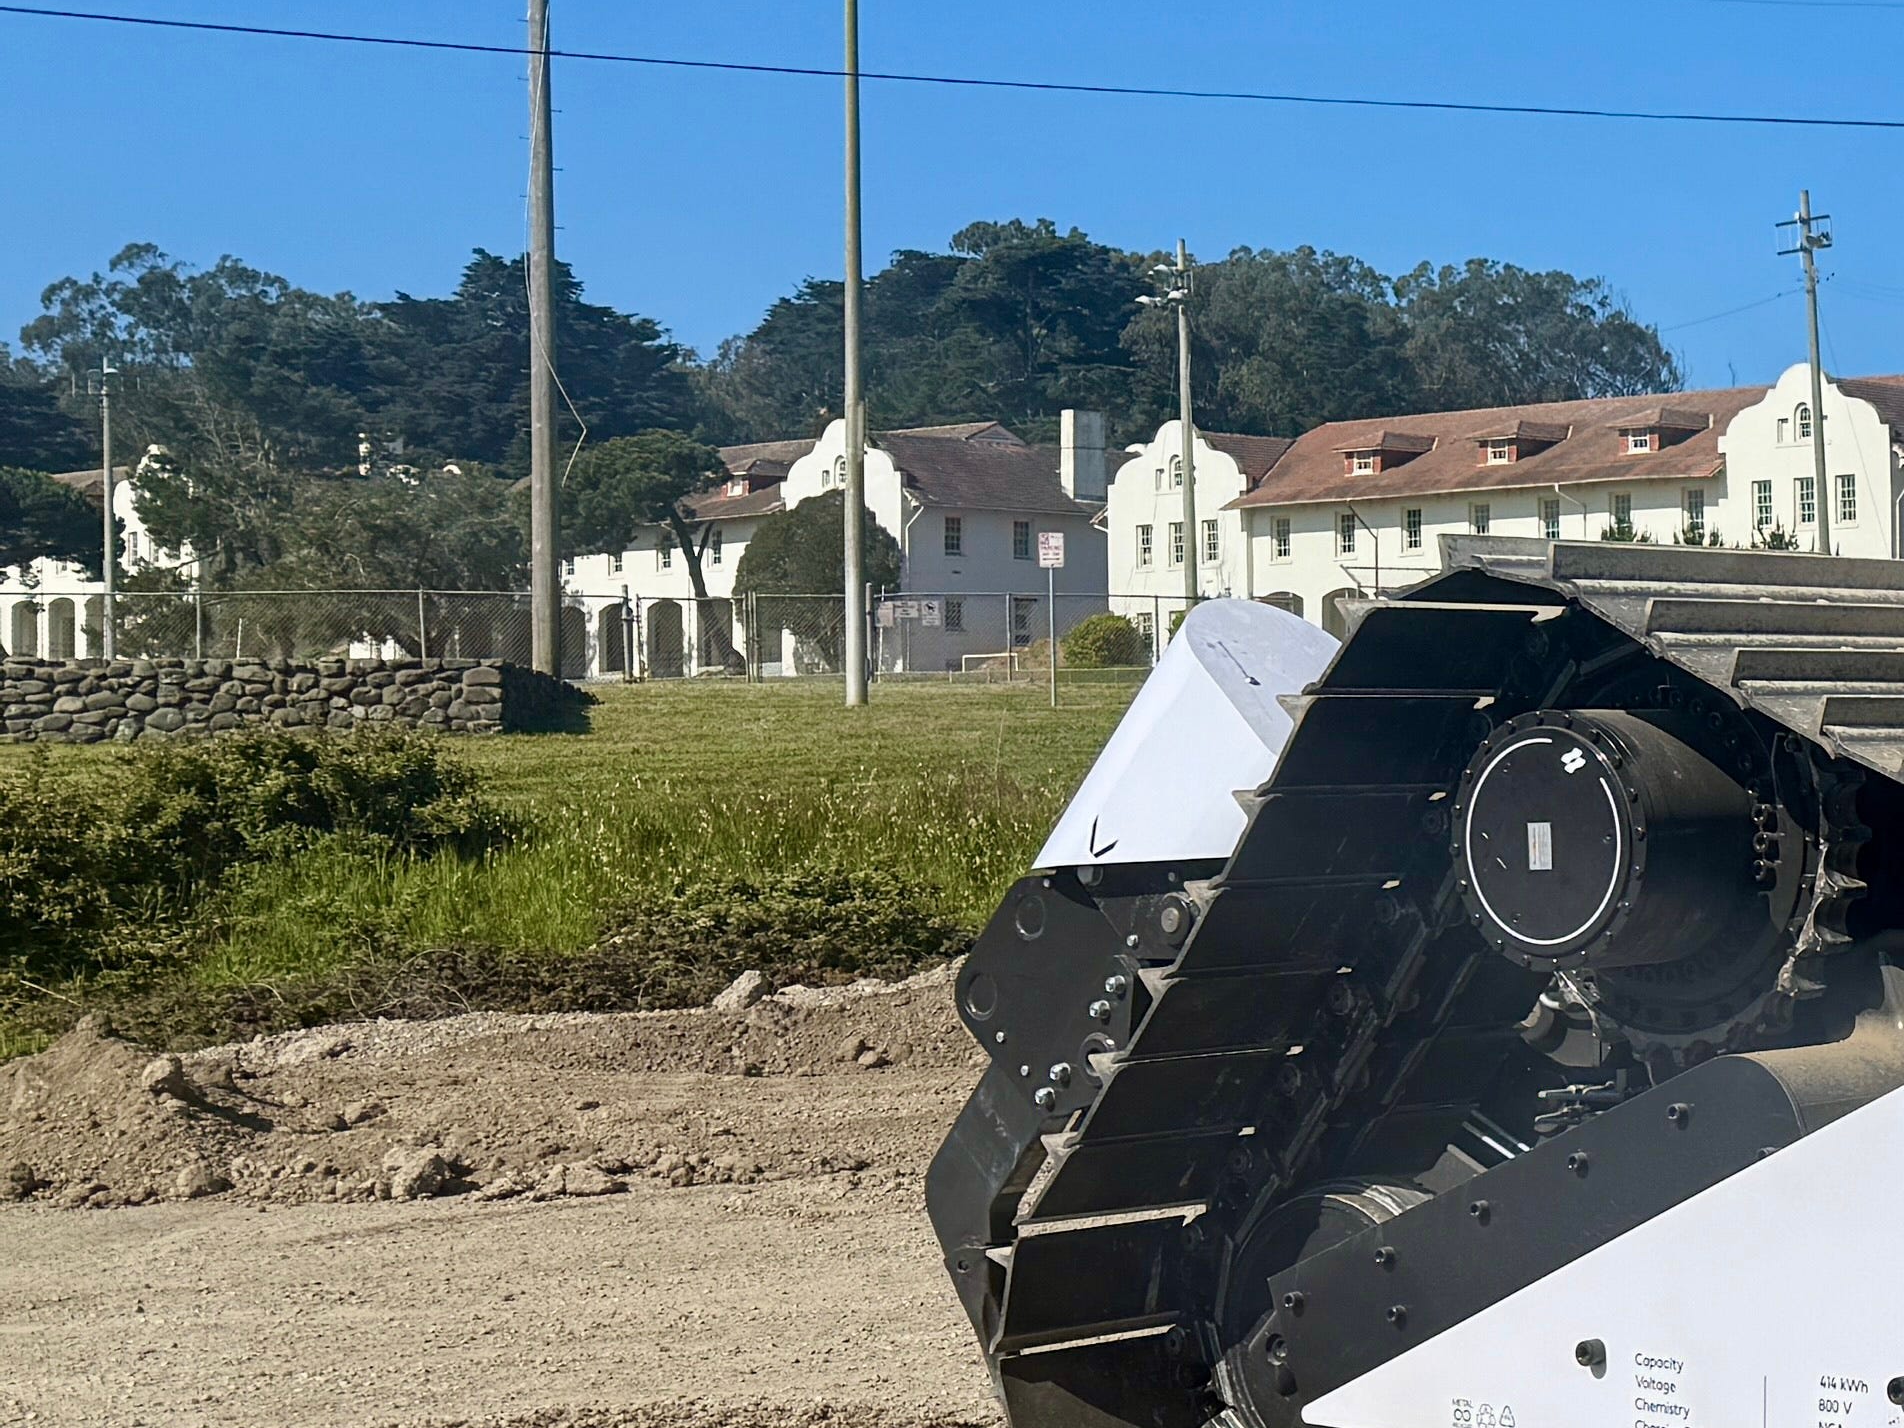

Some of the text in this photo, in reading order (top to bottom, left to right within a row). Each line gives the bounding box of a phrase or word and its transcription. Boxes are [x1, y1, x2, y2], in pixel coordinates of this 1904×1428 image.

[1635, 1353, 1684, 1374] Capacity
[1635, 1374, 1677, 1395] Voltage
[1840, 1378, 1869, 1394] kWh
[1635, 1397, 1690, 1420] Chemistry
[1818, 1398, 1853, 1414] 800 V
